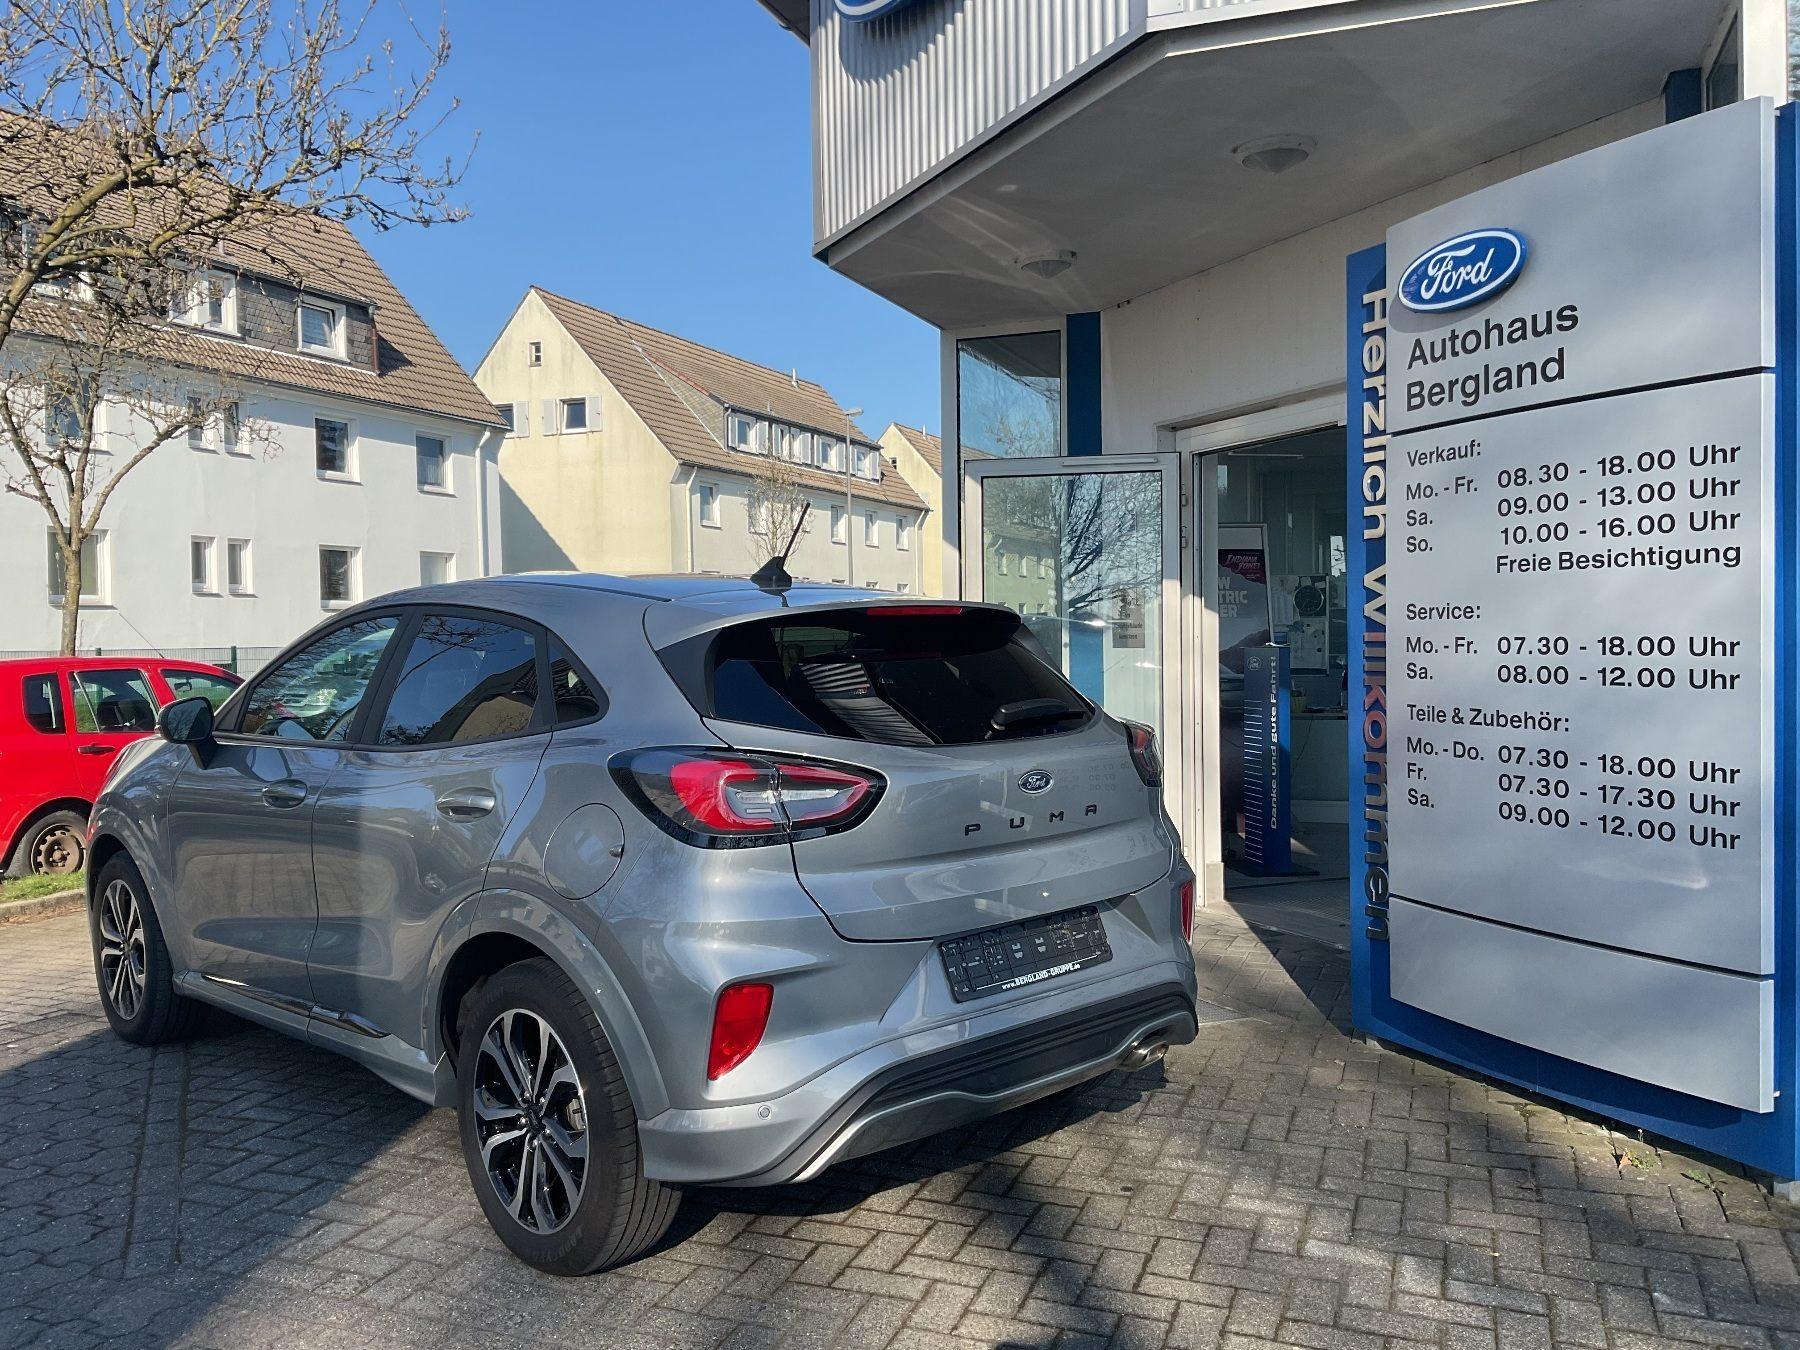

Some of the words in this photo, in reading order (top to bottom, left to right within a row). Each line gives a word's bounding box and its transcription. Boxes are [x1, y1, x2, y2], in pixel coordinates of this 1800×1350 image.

[1420, 244, 1494, 300] Ford
[1406, 304, 1579, 371] Autohaus
[1406, 346, 1566, 413] Bergland
[1406, 439, 1481, 467] Verkauf:
[1406, 482, 1439, 501] Mo.
[1454, 475, 1478, 495] Fr.
[1497, 462, 1569, 489] 08.30
[1596, 449, 1676, 477] 18.00
[1689, 444, 1741, 467] Uhr
[1406, 509, 1433, 527] Sa.
[1497, 492, 1569, 517] 09.00
[1597, 481, 1676, 508] 13.00
[1689, 476, 1741, 500] Uhr
[1406, 535, 1433, 554] So.
[1500, 521, 1569, 546] 10.00
[1597, 513, 1676, 538] 16.00
[1689, 509, 1741, 532] Uhr
[1496, 553, 1552, 574] Freie
[1558, 545, 1741, 571] Besichtigung
[1406, 602, 1481, 621] Service:
[1406, 636, 1439, 654] Mo.
[1454, 636, 1478, 655] Fr.
[1497, 636, 1569, 656] 07.30
[1597, 635, 1676, 657] 18.00
[1689, 636, 1741, 657] Uhr
[1406, 662, 1433, 680] Sa.
[1497, 664, 1569, 685] 08.00
[1597, 666, 1676, 689] 12.00
[1688, 668, 1741, 690] Uhr
[1406, 703, 1447, 724] Teile
[1451, 707, 1465, 725] &
[1469, 707, 1570, 733] Zubehör:
[1406, 736, 1439, 756] Mo.
[1452, 740, 1485, 761] Do.
[1497, 744, 1569, 770] 07.30
[1597, 753, 1676, 779] 18.00
[1689, 760, 1741, 785] Uhr
[1407, 761, 1428, 781] Fr.
[1498, 773, 1570, 799] 07.30
[1597, 784, 1676, 811] 17.30
[1689, 792, 1741, 818] Uhr
[964, 803, 1097, 836] PUMA
[1407, 787, 1435, 809] Sa.
[1498, 801, 1570, 829] 09.00
[1597, 814, 1676, 843] 12.00
[1689, 824, 1741, 850] Uhr
